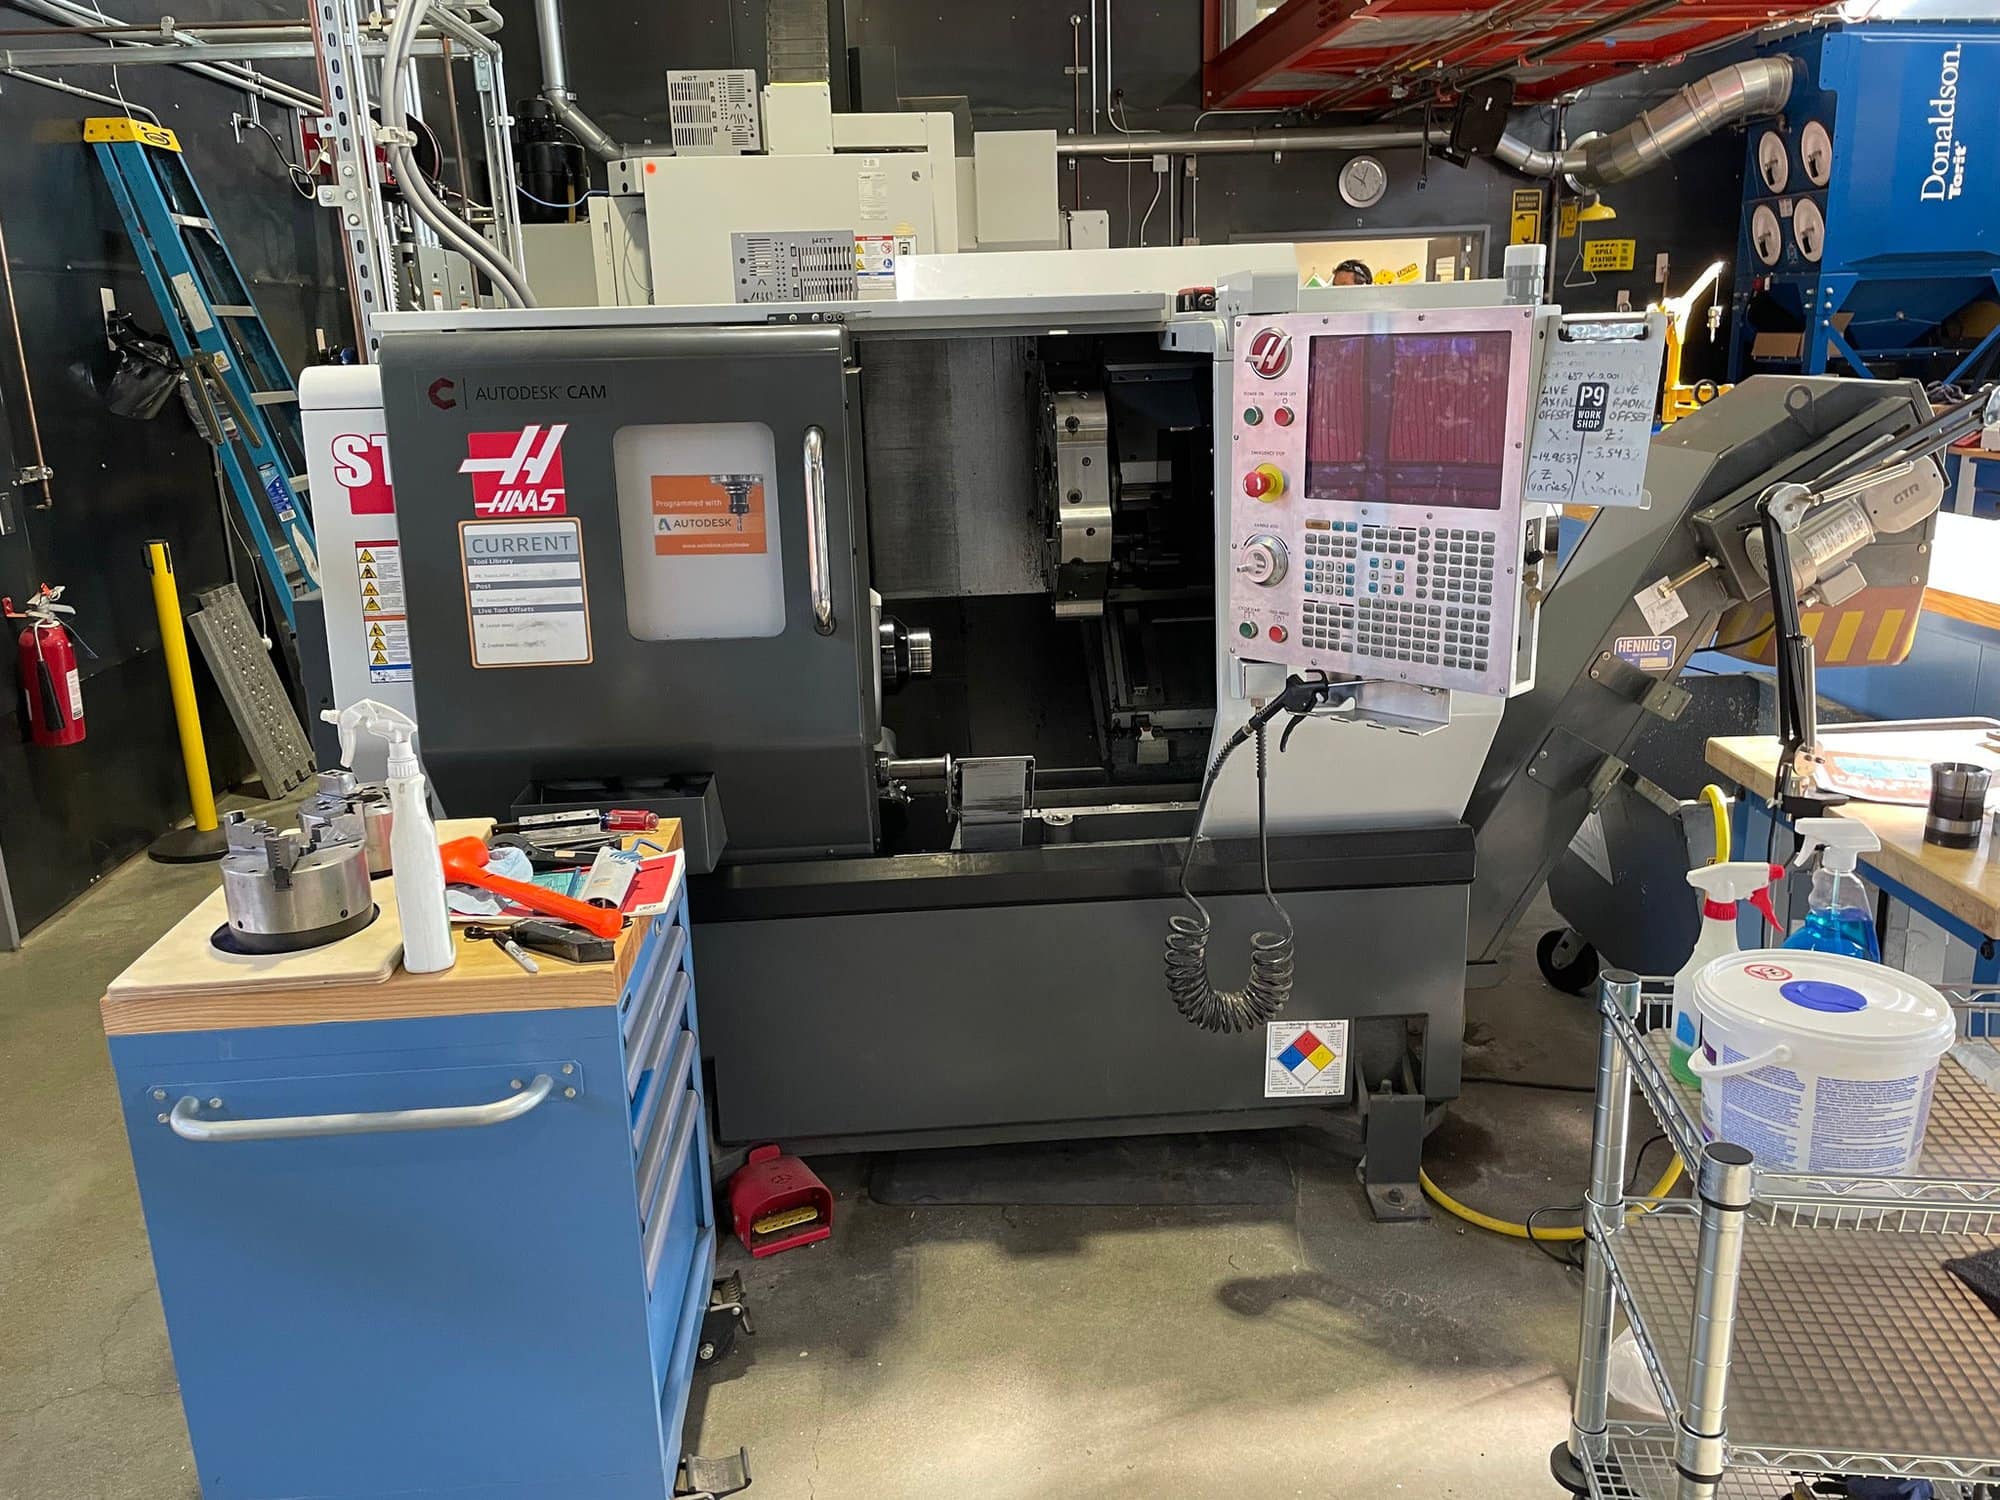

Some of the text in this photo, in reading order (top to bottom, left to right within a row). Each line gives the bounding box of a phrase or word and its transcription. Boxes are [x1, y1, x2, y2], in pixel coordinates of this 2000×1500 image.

[1948, 140, 1967, 200] Torit
[475, 386, 560, 401] AUTODESK
[566, 385, 607, 399] CAM
[1541, 385, 1569, 395] LIVE
[1614, 384, 1640, 395] LIVE
[1541, 397, 1576, 408] AXIAL
[1579, 386, 1605, 407] P9
[1577, 410, 1602, 419] WORK
[1576, 420, 1601, 429] SHOP
[1893, 482, 1921, 505] GTR
[475, 488, 565, 513] HAAS
[673, 519, 732, 528] AUTODESK
[472, 535, 572, 554] CURRENT
[489, 558, 514, 566] Library
[1618, 639, 1660, 652] HENNIG
